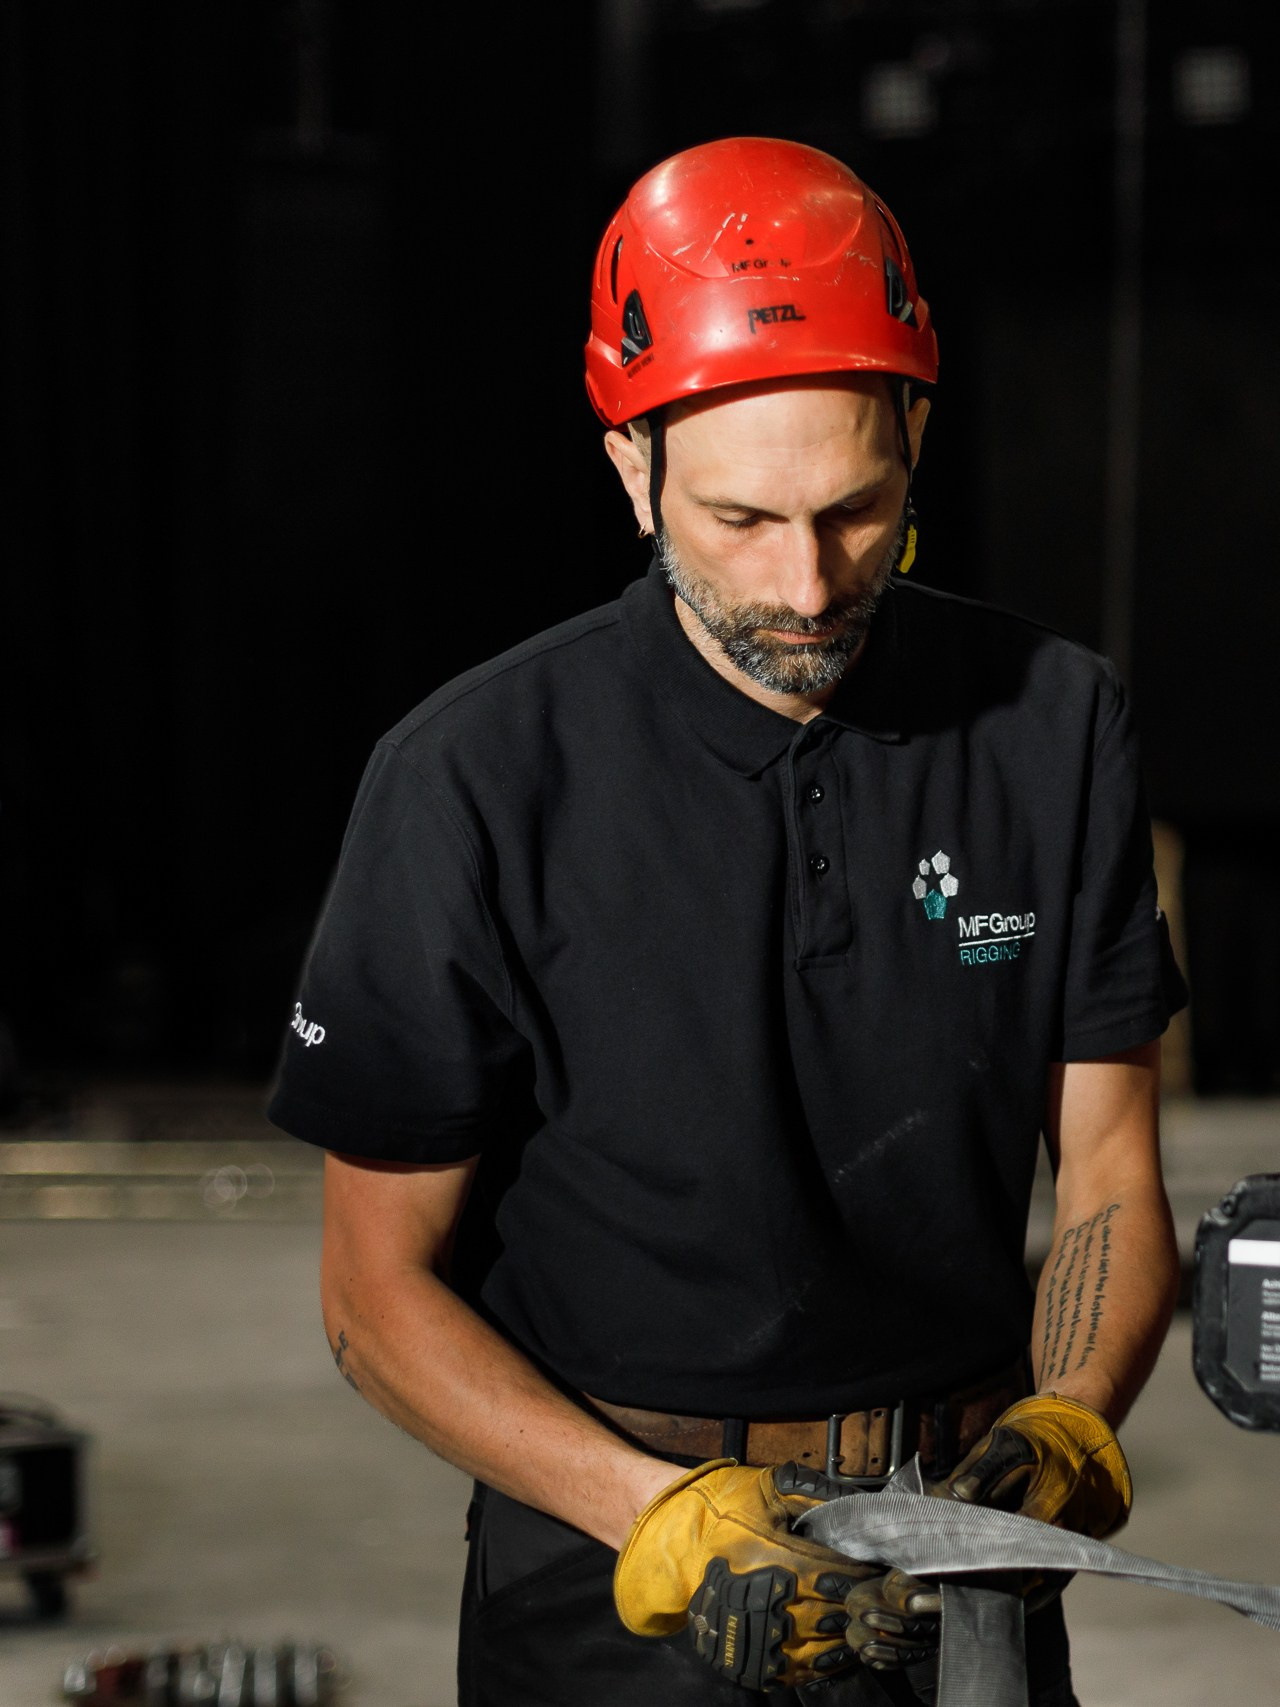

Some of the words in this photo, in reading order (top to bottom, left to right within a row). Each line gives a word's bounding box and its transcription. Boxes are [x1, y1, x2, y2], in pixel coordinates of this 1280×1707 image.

[748, 304, 806, 335] PETZL
[958, 912, 1036, 938] MFGroup
[960, 942, 1021, 965] RIGGING
[1098, 1259, 1110, 1273] last
[1095, 1275, 1109, 1292] tree
[1091, 1294, 1105, 1311] has
[1089, 1311, 1104, 1331] been
[1087, 1332, 1097, 1344] cut
